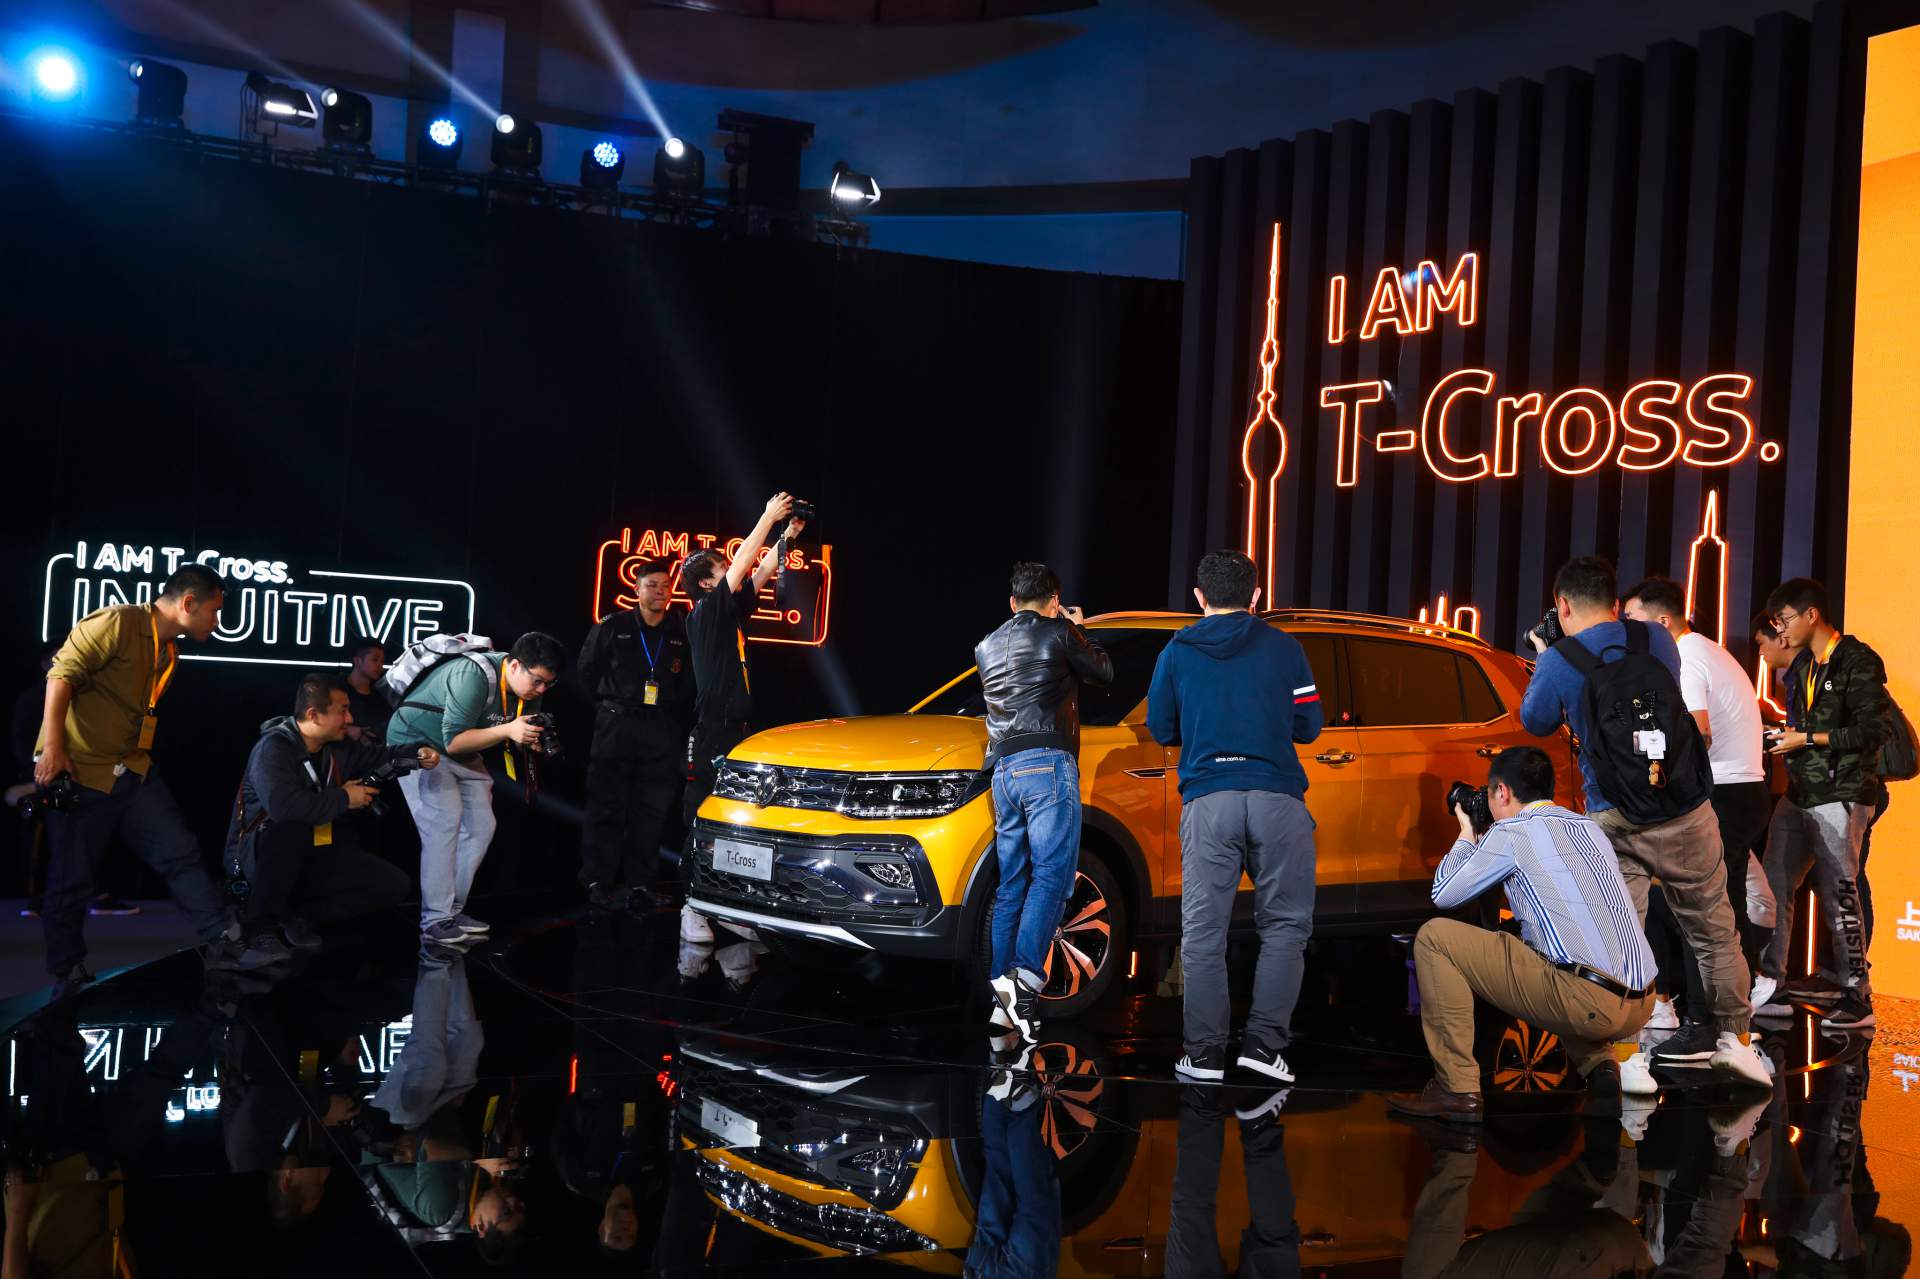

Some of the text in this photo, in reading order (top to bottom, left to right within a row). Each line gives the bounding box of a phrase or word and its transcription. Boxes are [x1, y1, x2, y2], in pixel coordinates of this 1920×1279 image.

[1328, 252, 1478, 344] I AM
[1320, 368, 1781, 487] T-Cross.
[76, 541, 87, 569] I
[94, 542, 153, 574] AM
[621, 527, 631, 554] I
[637, 529, 689, 558] AM
[72, 577, 444, 649] IUITIVE
[726, 850, 757, 869] T-Cross
[1838, 879, 1867, 978] HOLLISTER
